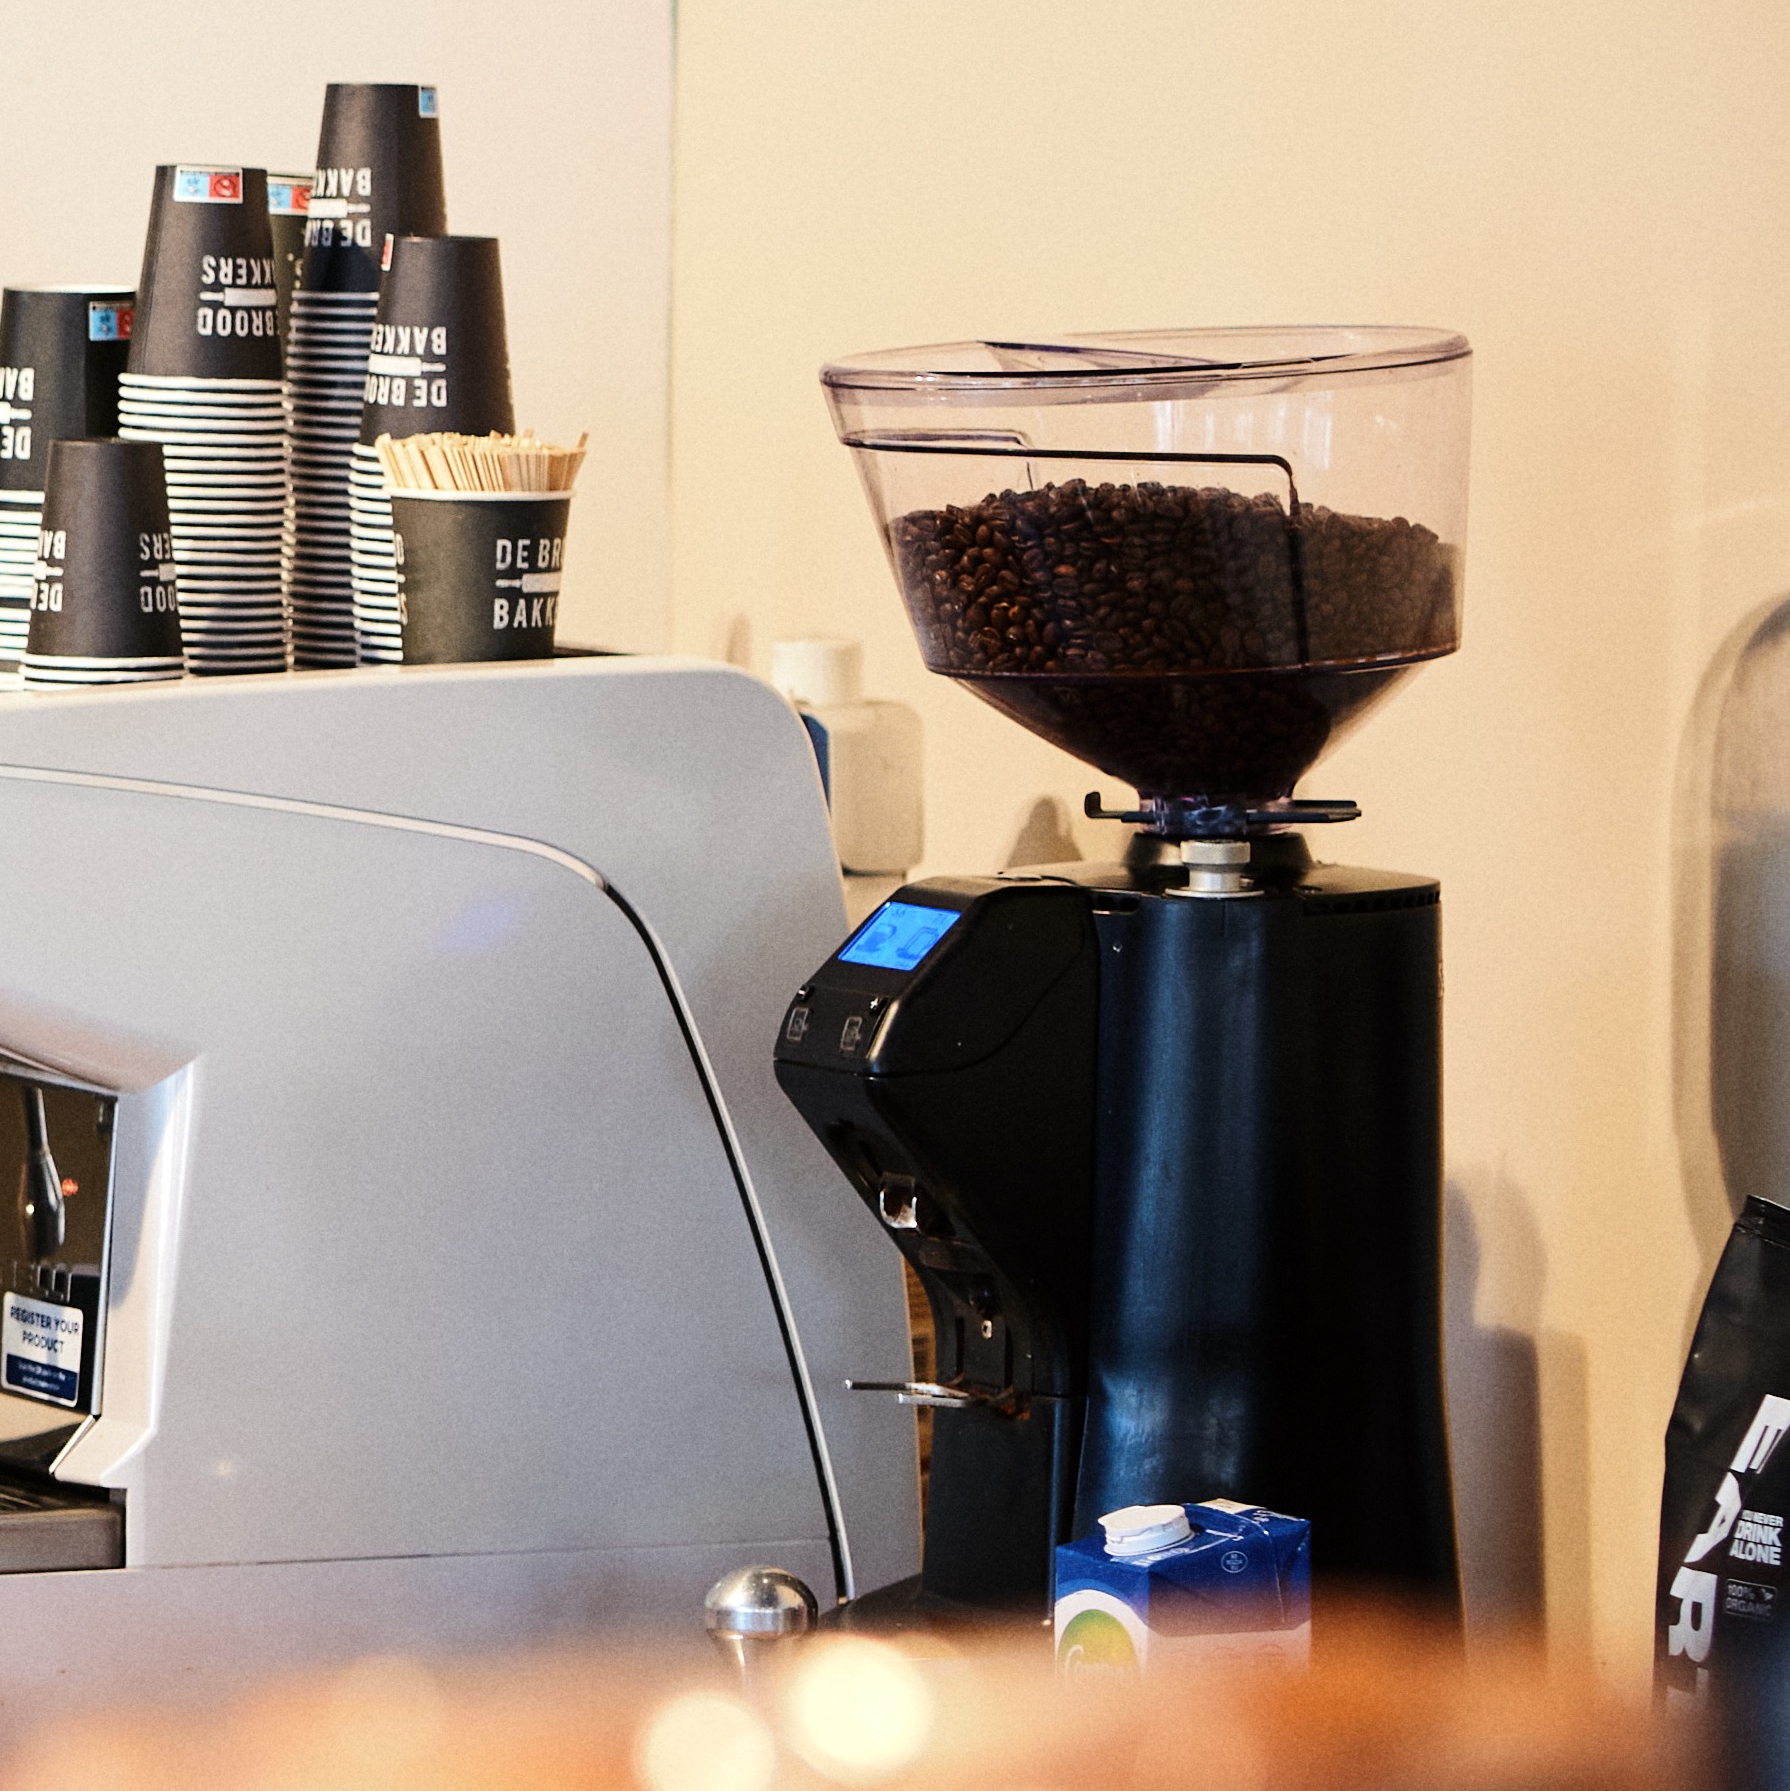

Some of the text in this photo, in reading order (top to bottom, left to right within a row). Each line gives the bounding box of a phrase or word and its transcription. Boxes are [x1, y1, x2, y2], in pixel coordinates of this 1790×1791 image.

[313, 167, 372, 197] BAKK
[339, 218, 372, 247] DE
[201, 254, 275, 285] KKERS
[197, 306, 275, 337] BROOD
[412, 378, 447, 408] DE
[0, 425, 32, 460] DE
[496, 537, 564, 570] DE BR
[38, 582, 63, 612] DE
[493, 597, 558, 630] BAKK
[10, 1306, 79, 1335] REGISTER YOUR
[22, 1331, 64, 1352] PRODUCT
[1734, 1519, 1783, 1547] DRINK
[1729, 1539, 1781, 1566] ALONE
